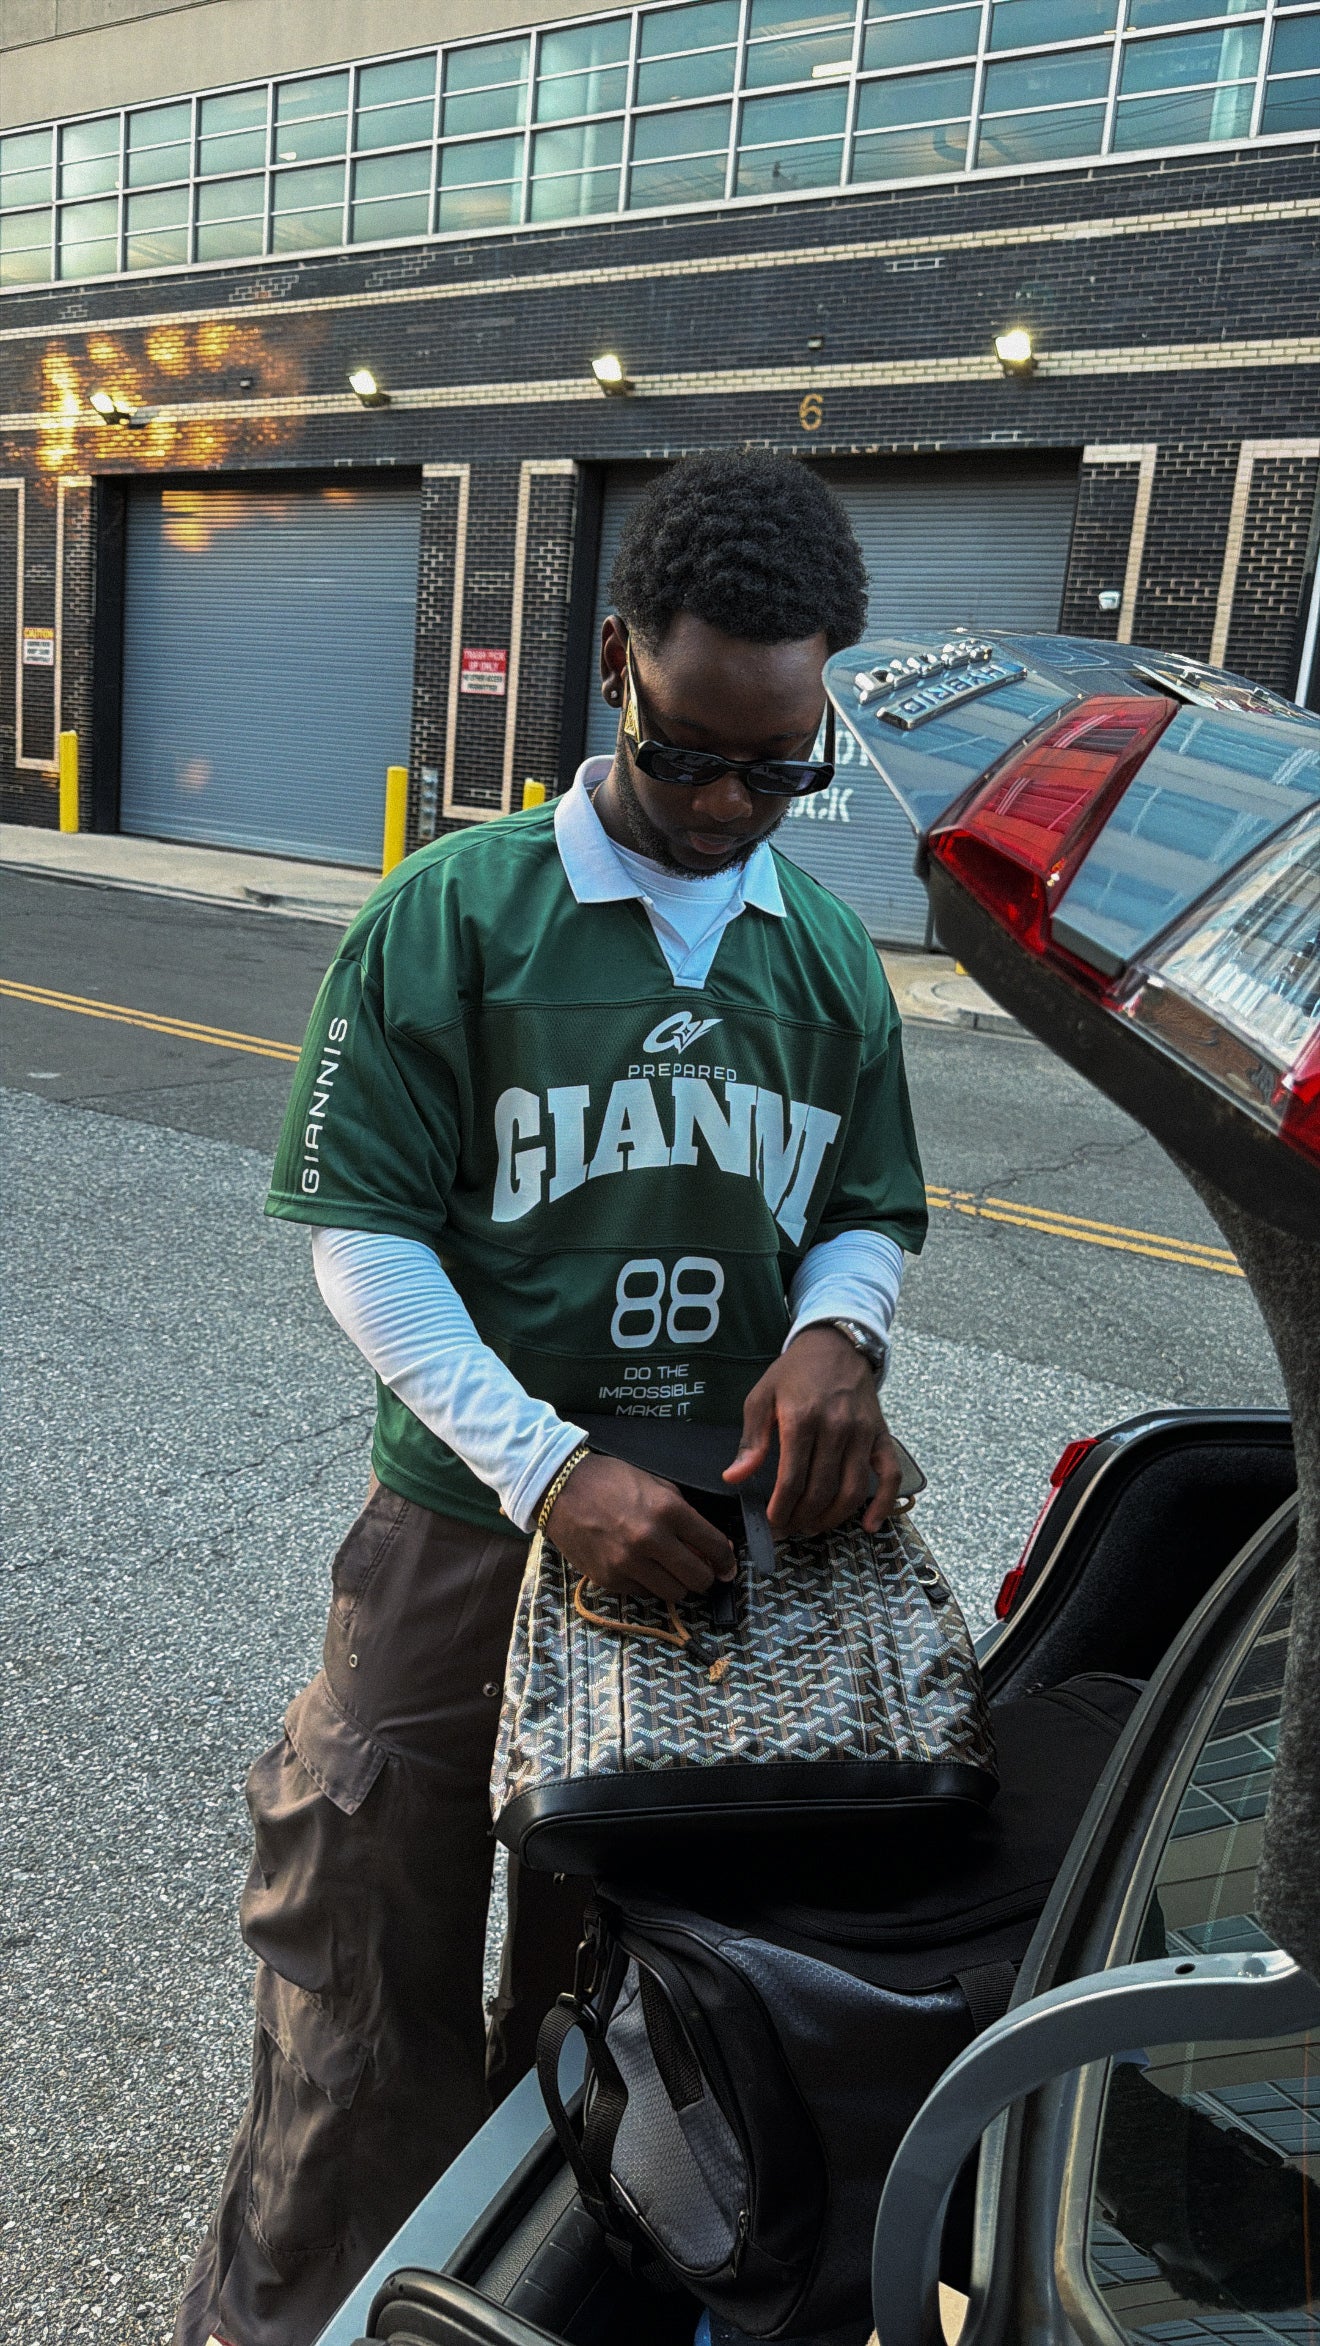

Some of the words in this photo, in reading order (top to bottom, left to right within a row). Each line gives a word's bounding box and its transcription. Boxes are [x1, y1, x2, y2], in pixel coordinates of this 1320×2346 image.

[799, 393, 824, 432] 6
[628, 1062, 737, 1082] PREPARED
[301, 1017, 348, 1194] GIANNIS
[610, 1256, 725, 1349] 88
[624, 1366, 651, 1381] DO
[657, 1363, 690, 1379] THE
[598, 1381, 706, 1399] IMPOSSIBLE
[615, 1404, 672, 1418] MAKE
[677, 1401, 691, 1416] IT
